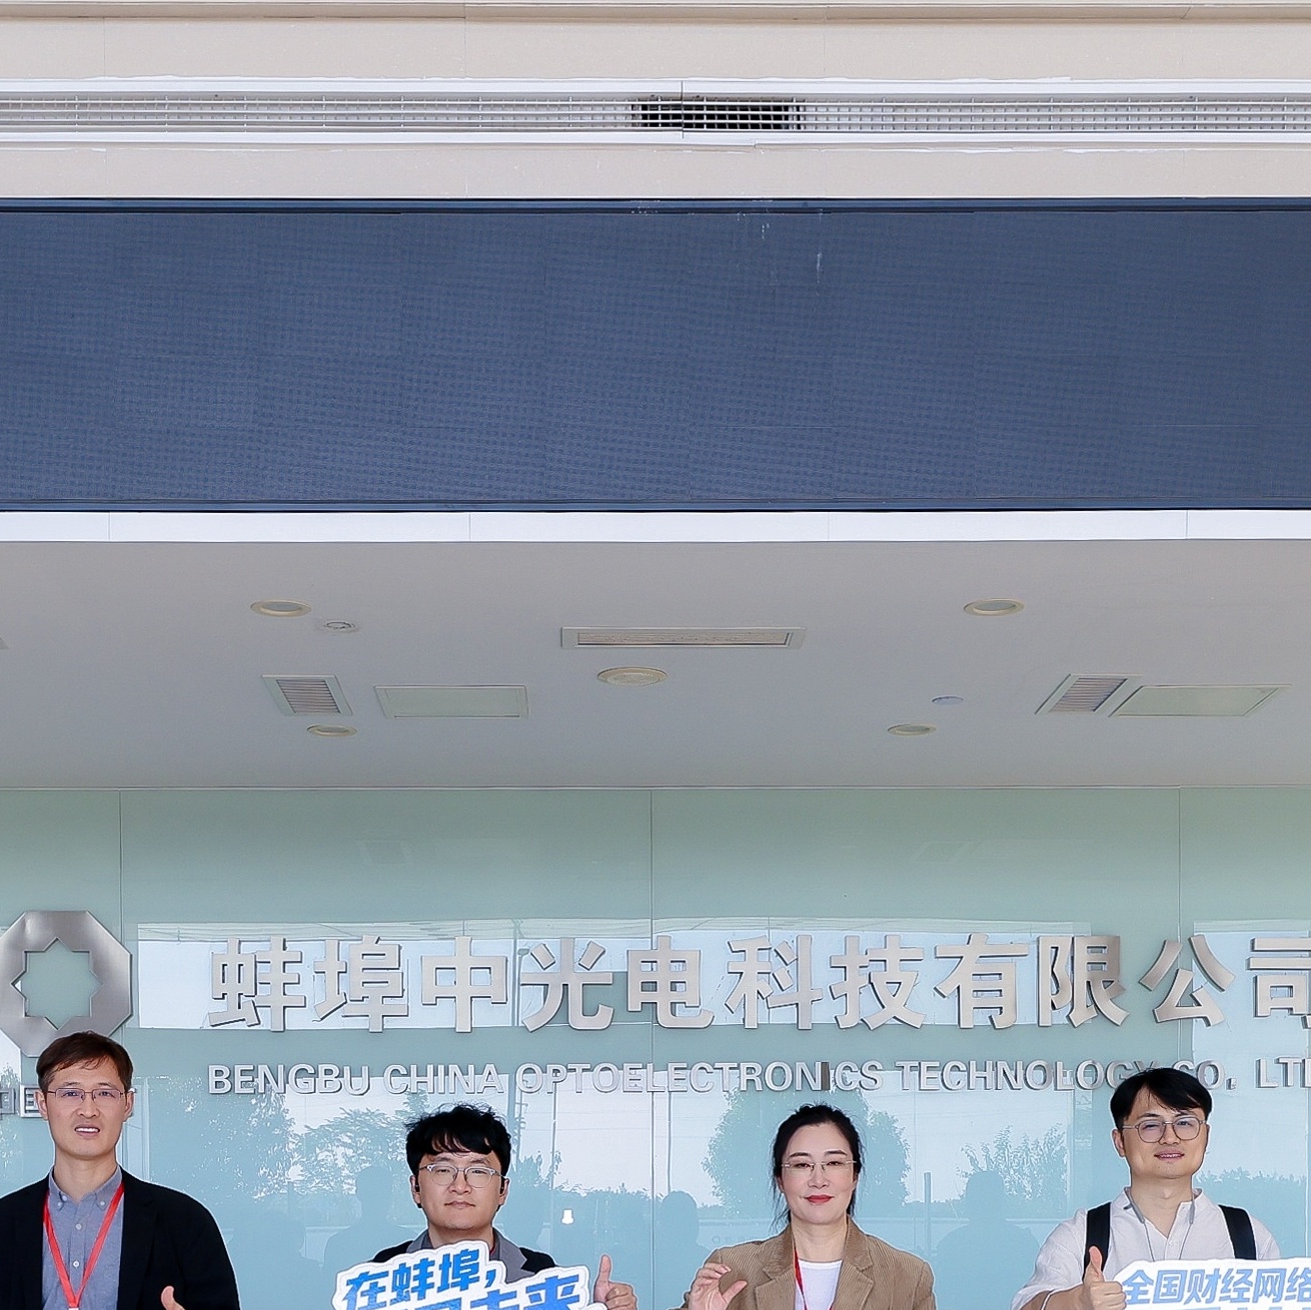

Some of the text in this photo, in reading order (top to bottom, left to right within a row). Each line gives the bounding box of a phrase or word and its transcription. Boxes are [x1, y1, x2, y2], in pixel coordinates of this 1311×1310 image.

[208, 1064, 370, 1096] BENGBU
[384, 1063, 503, 1095] CHINA
[514, 1061, 882, 1093] OPTOELECTRONICS
